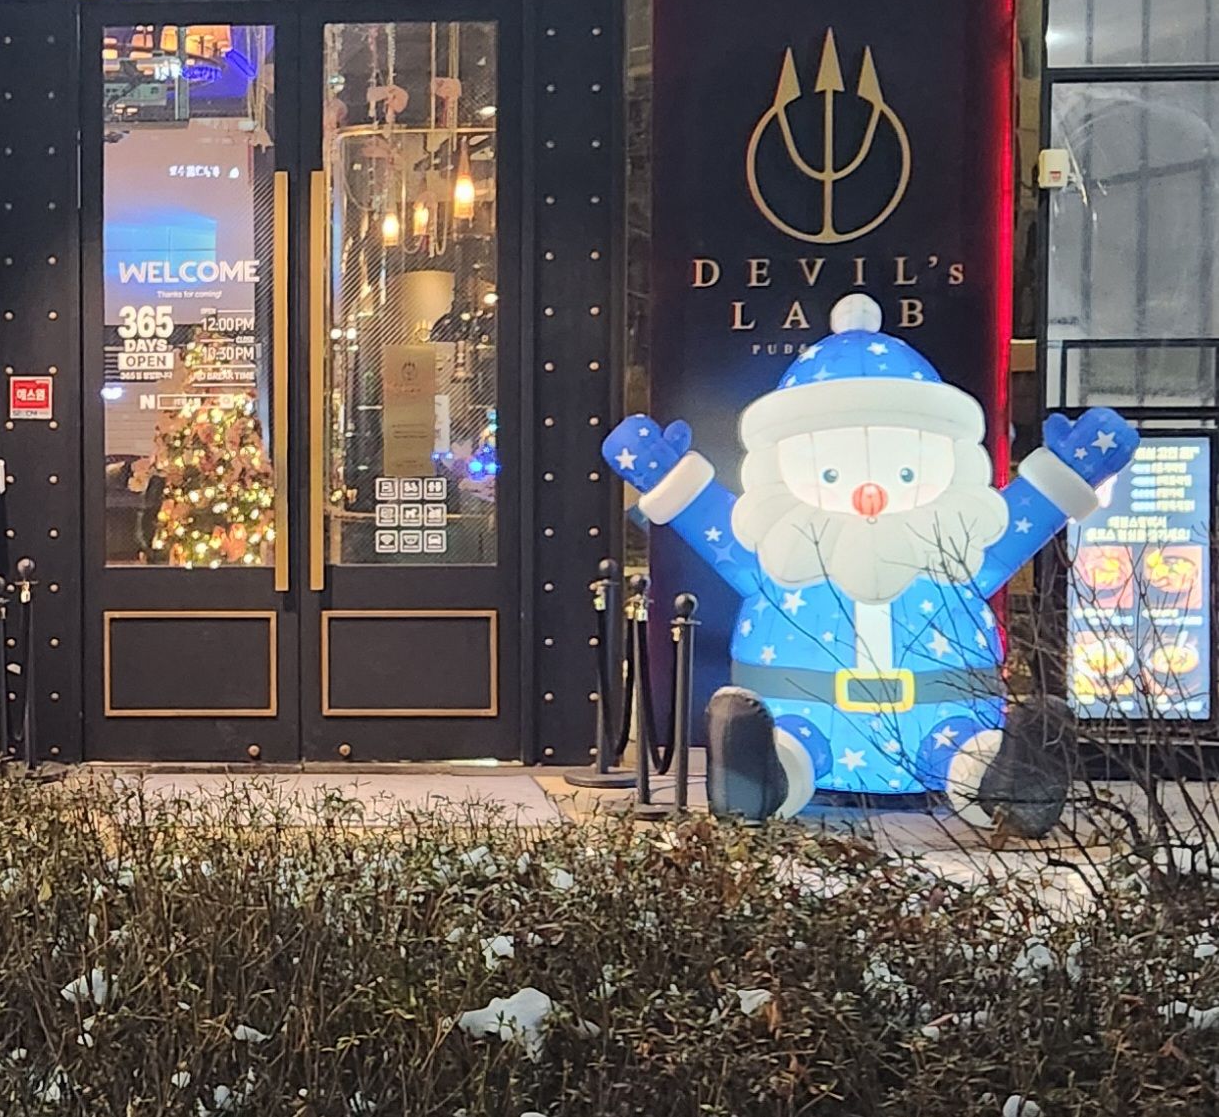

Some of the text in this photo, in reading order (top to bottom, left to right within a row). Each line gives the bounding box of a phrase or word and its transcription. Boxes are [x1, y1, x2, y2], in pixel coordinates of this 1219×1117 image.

[118, 260, 260, 283] WELCOME
[692, 255, 965, 287] DEVIL's
[117, 305, 174, 338] 365
[731, 298, 924, 330] LAB
[124, 339, 168, 352] DAYS
[126, 356, 167, 367] OPEN
